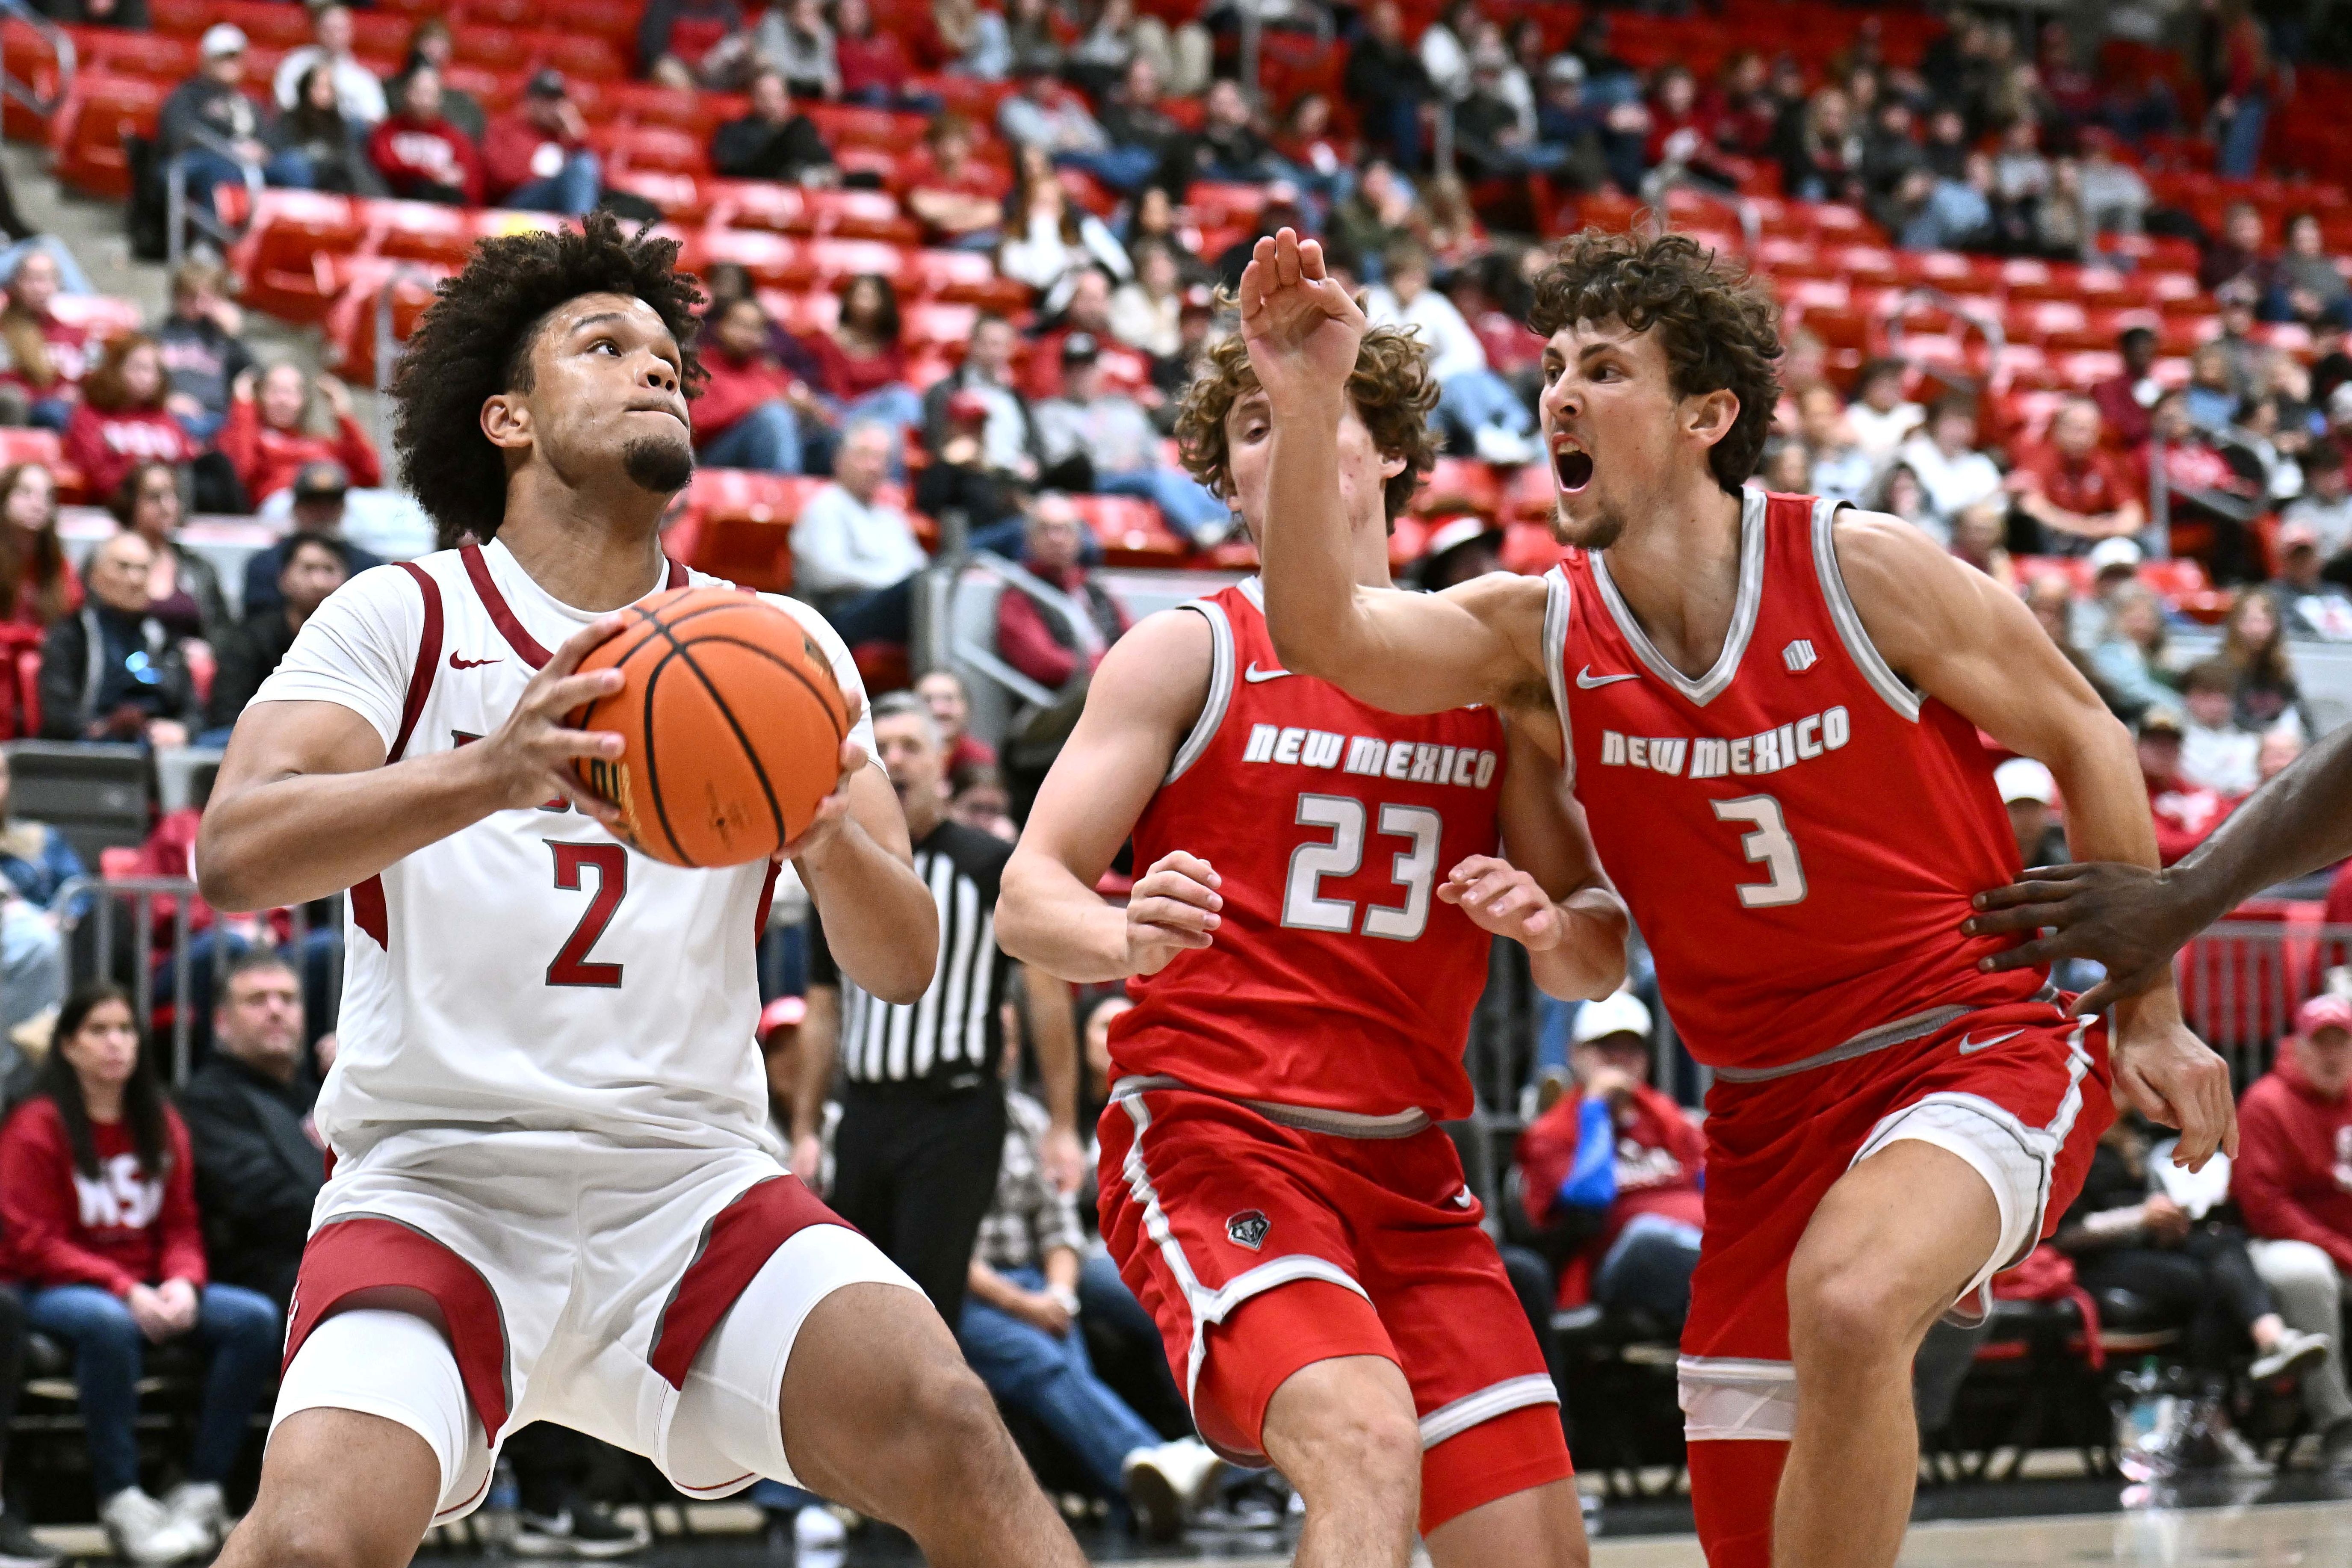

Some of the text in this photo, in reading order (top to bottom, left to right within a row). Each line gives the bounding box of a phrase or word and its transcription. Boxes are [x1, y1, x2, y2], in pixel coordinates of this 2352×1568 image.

[1242, 723, 1496, 789] NEW MEXICO
[1601, 706, 1849, 779] NEW MEXICO
[1280, 792, 1443, 942] 23
[1709, 794, 1808, 908] 3
[543, 839, 627, 989] 2
